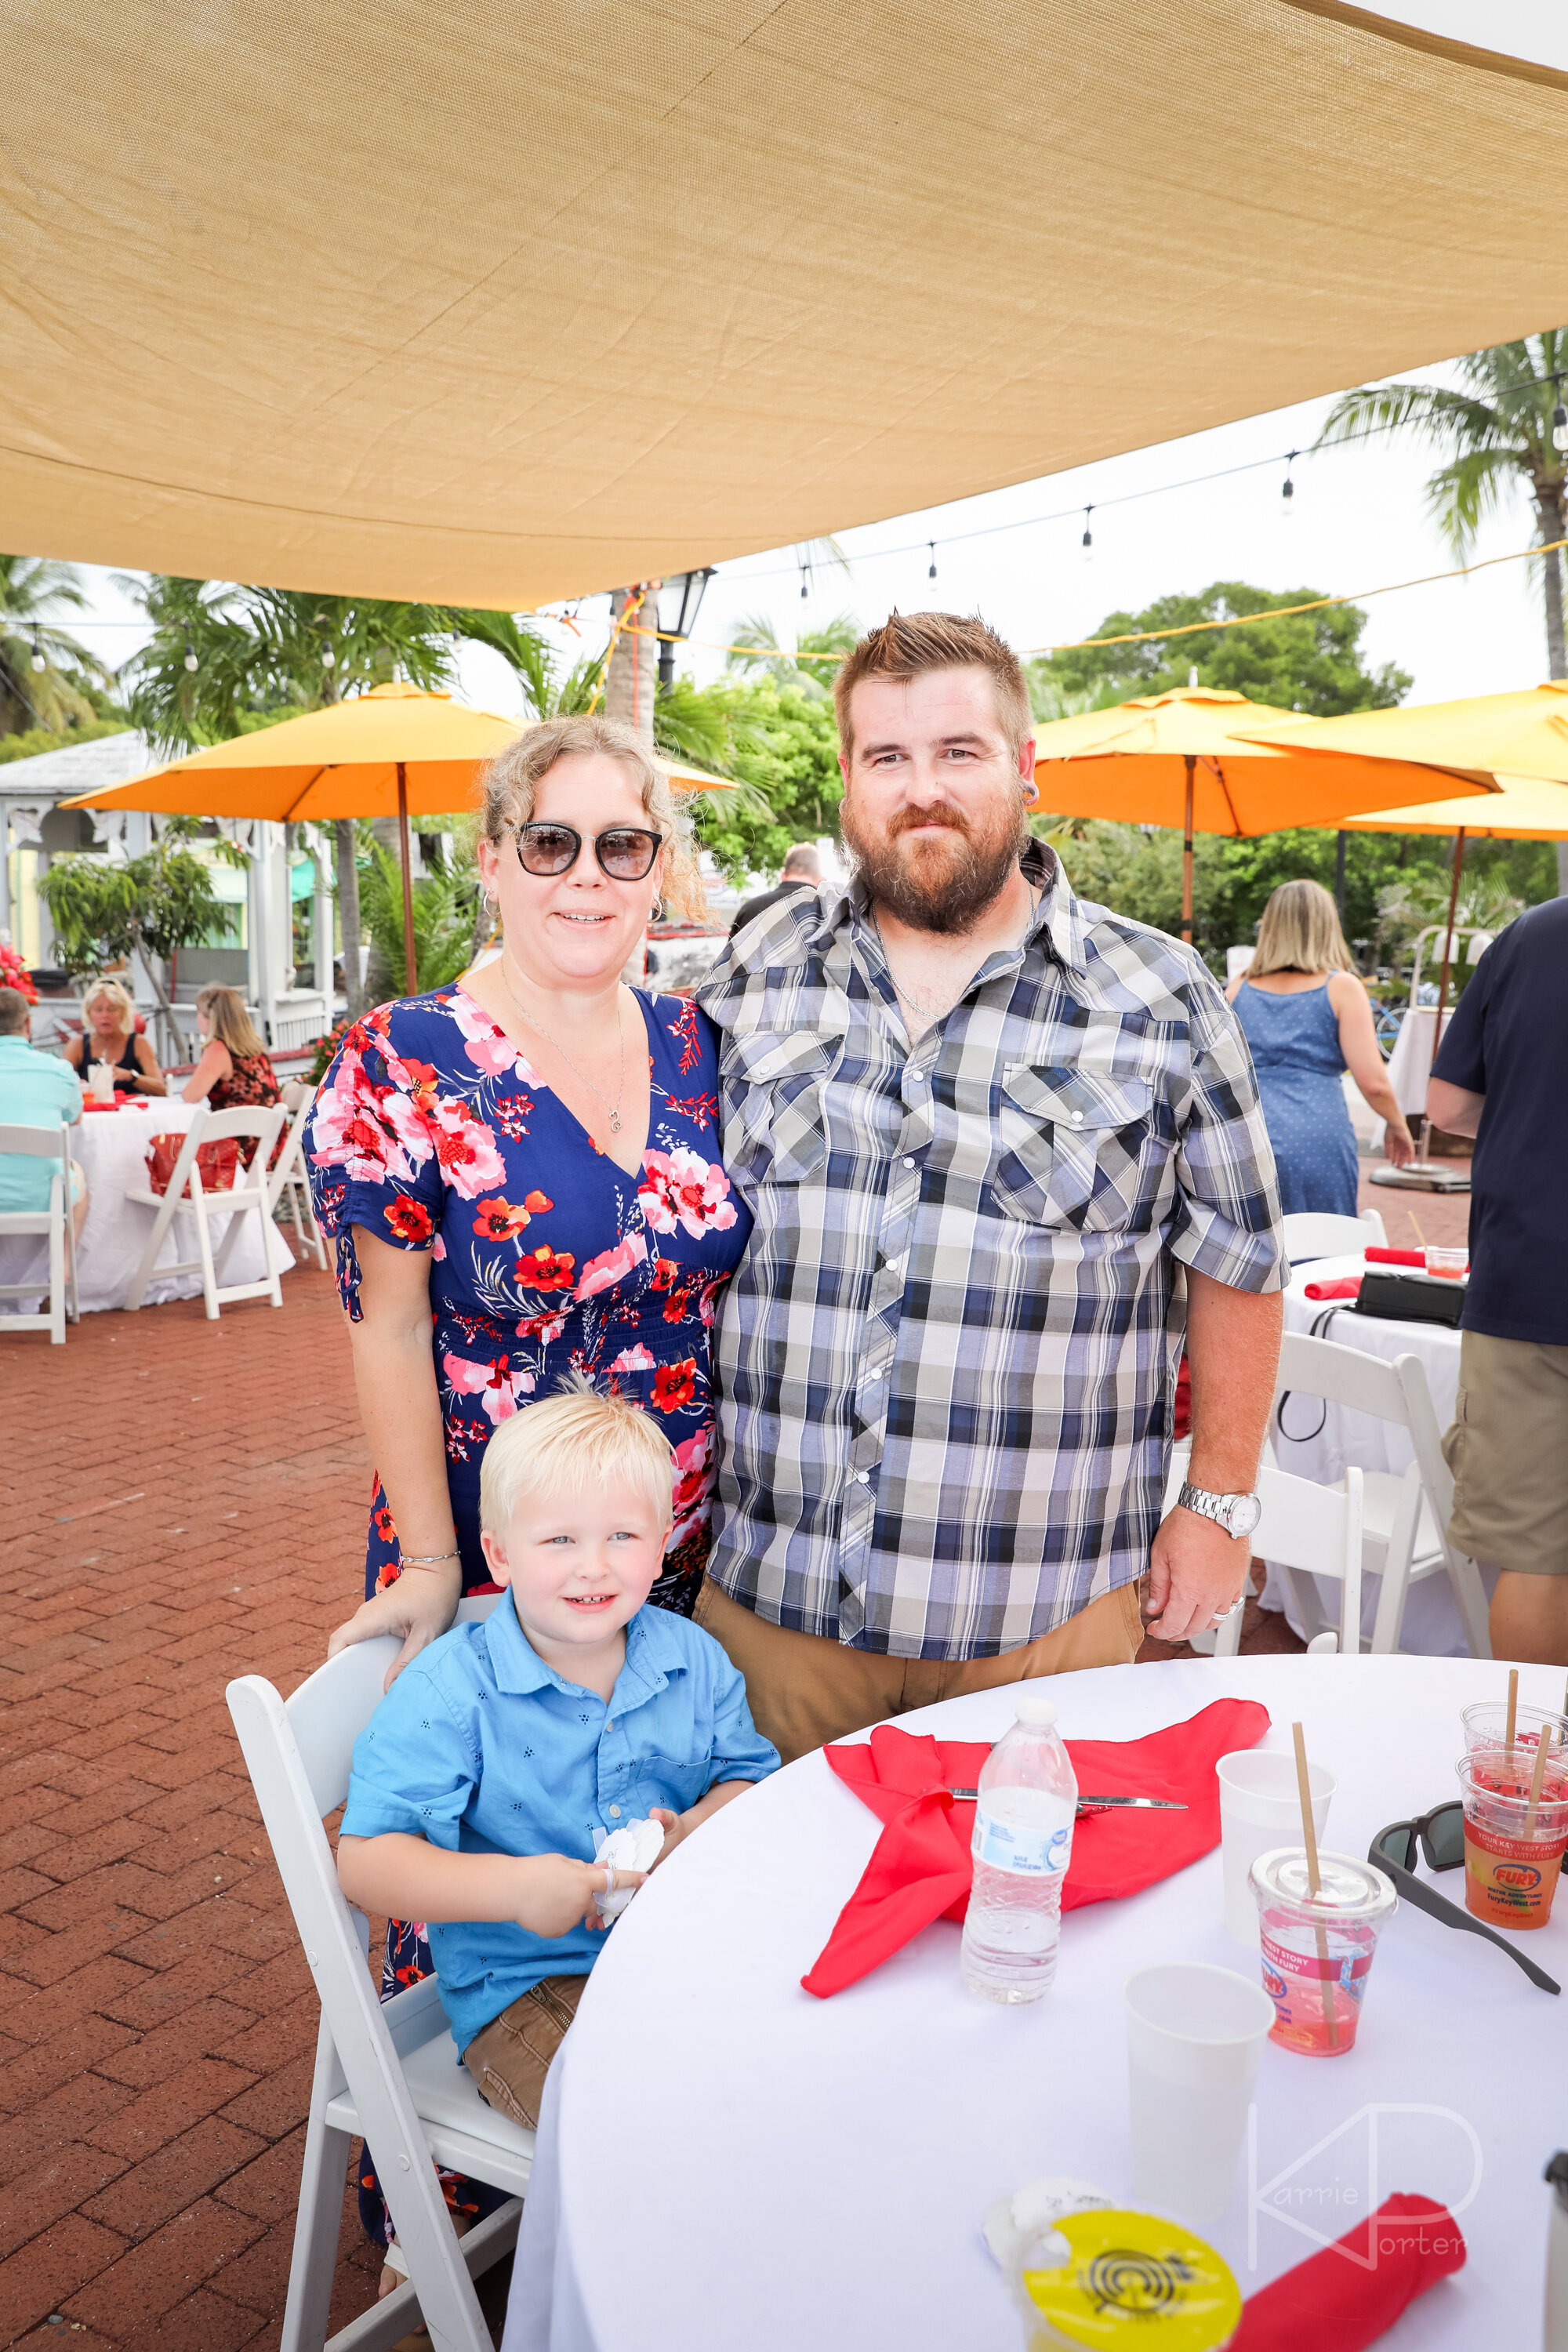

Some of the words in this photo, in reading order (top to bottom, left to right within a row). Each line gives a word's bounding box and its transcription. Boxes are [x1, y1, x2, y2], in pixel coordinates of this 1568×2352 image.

[1478, 1831, 1497, 1845] YOUR
[1499, 1840, 1515, 1849] KEY
[1486, 1844, 1512, 1857] STARTS
[1495, 1868, 1538, 1886] FURY
[1487, 1886, 1506, 1896] WATER
[1487, 1893, 1541, 1906] FuryKeyWest.com
[1279, 1958, 1300, 1972] FURY
[1281, 1951, 1309, 1966] STORY
